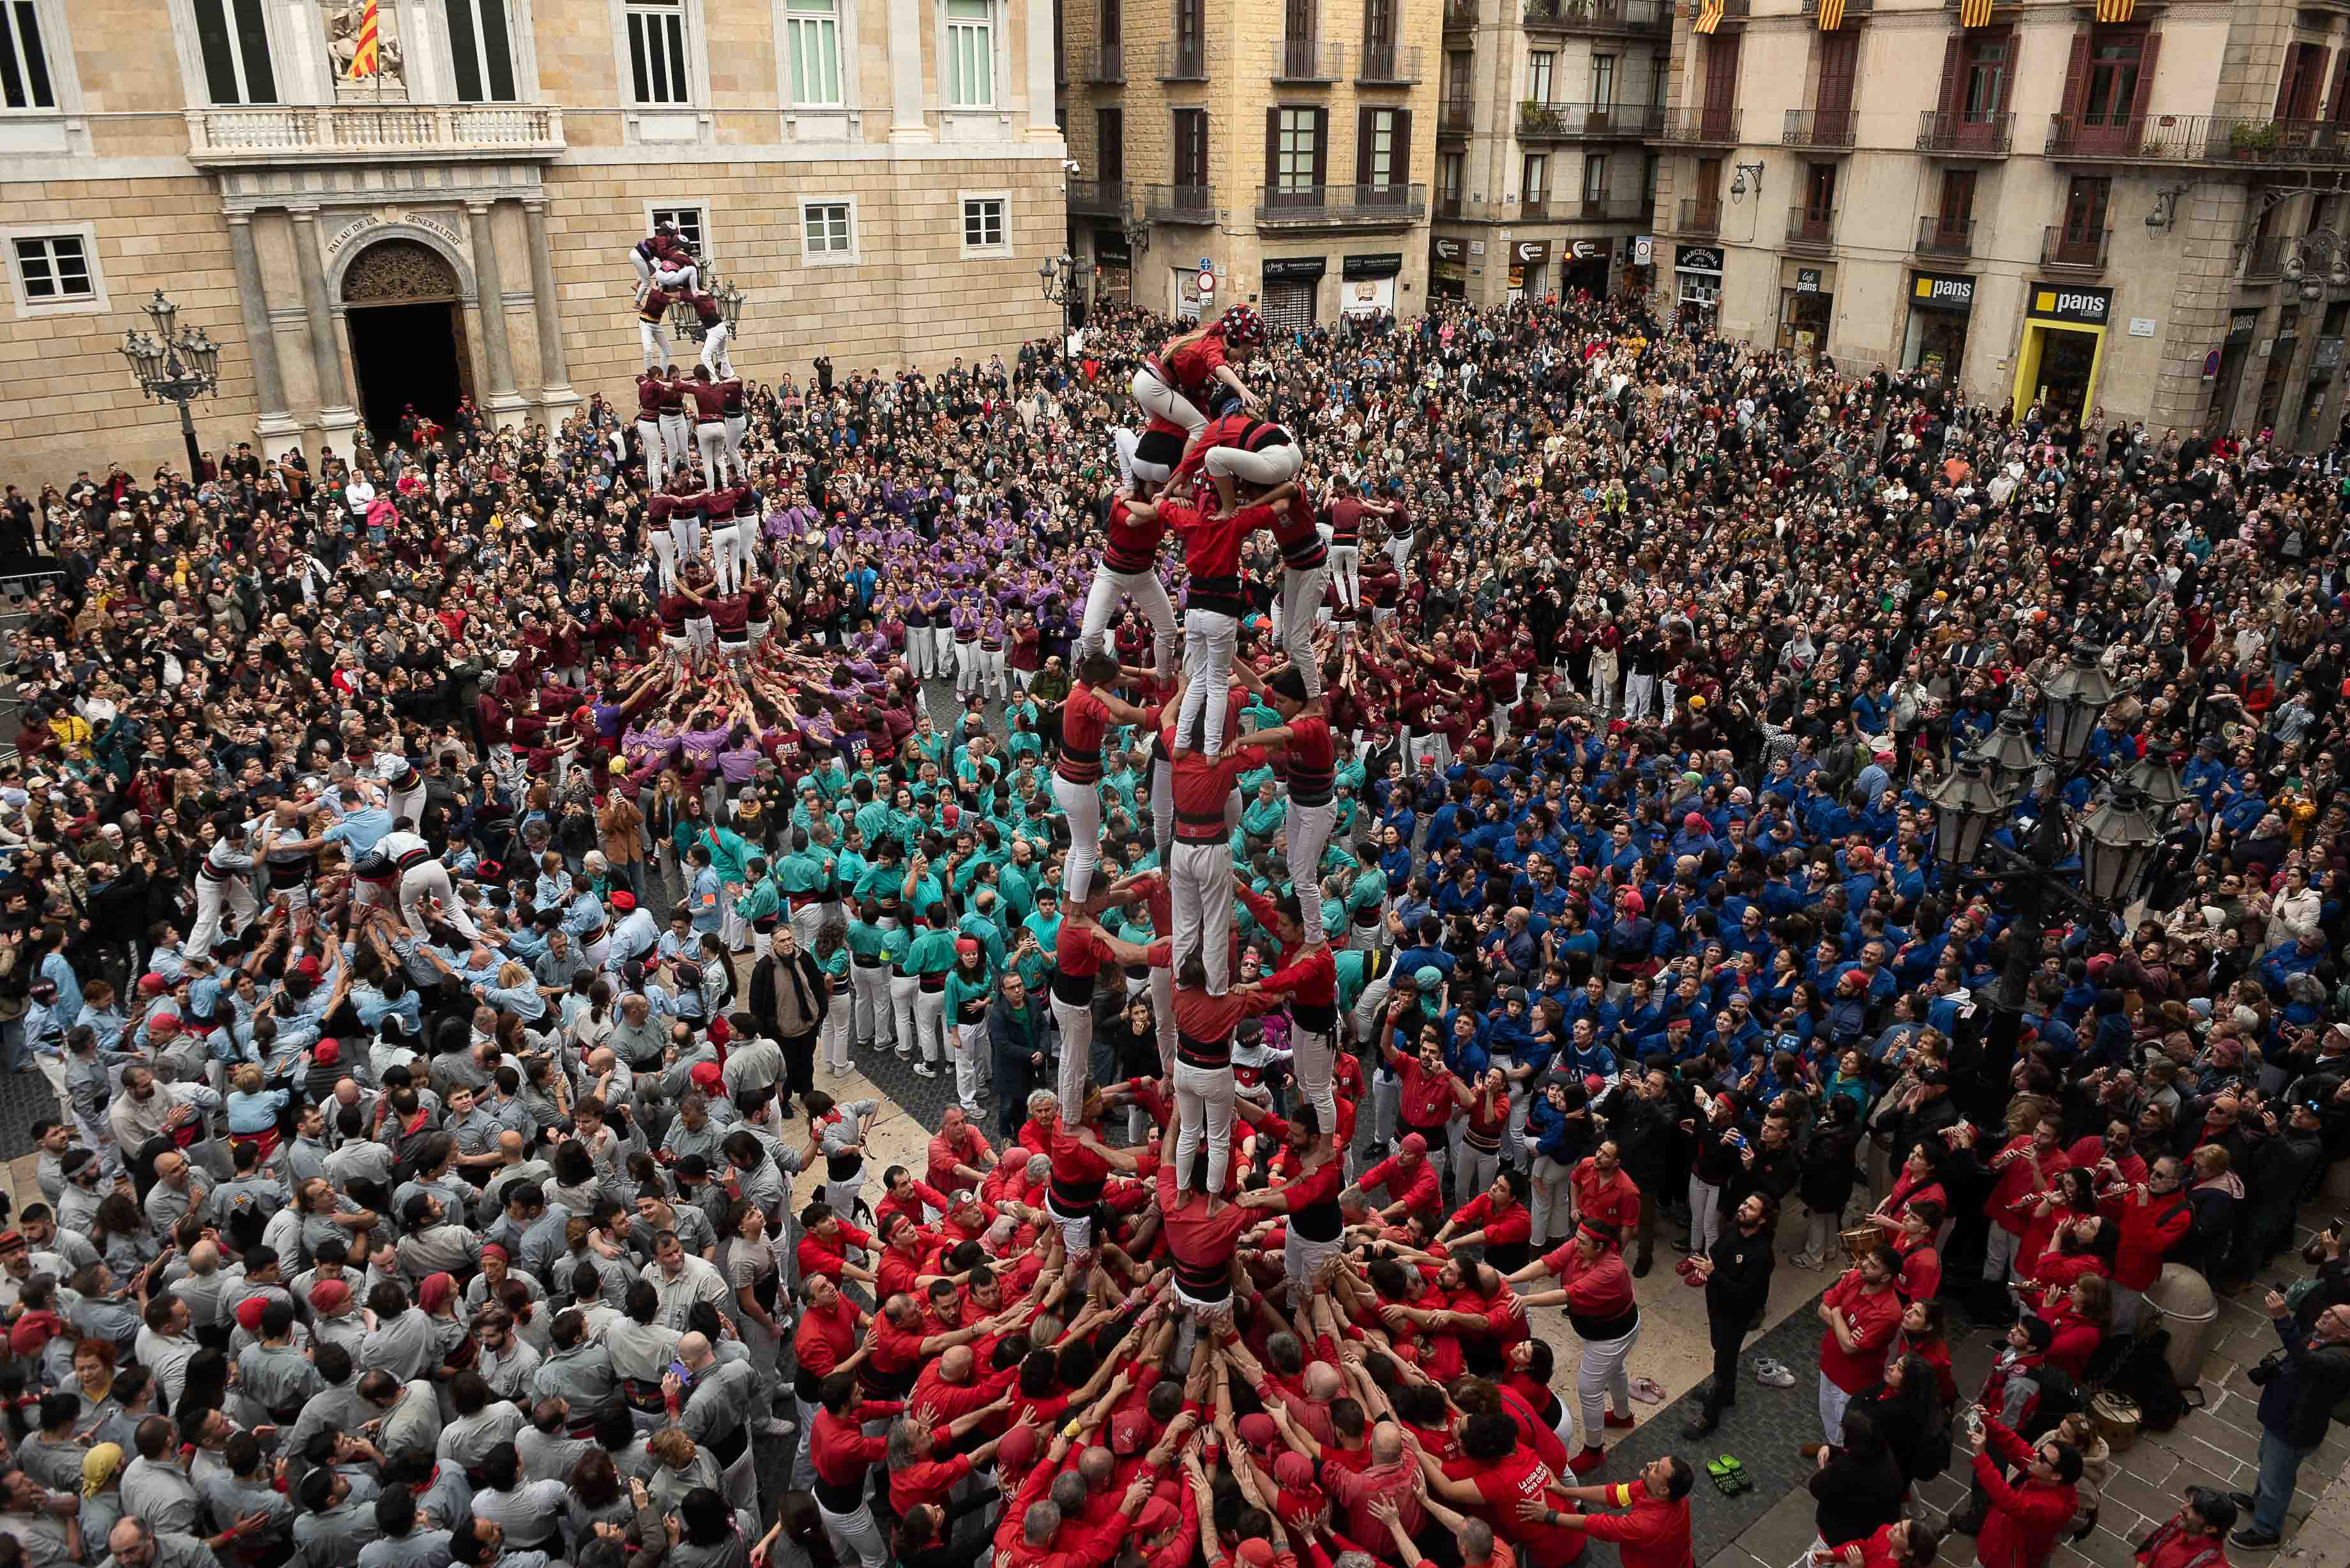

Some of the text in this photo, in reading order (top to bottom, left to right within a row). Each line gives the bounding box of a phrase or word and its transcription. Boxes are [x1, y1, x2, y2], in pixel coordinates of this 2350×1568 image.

[328, 215, 461, 253] PALAU DE LA GENERALITAT
[1682, 249, 1717, 266] BARCELONA
[1797, 282, 1817, 292] pans
[1933, 280, 1971, 298] pans
[2057, 293, 2105, 313] pans
[2231, 315, 2254, 336] pans
[2280, 329, 2294, 342] pans
[1517, 1481, 1527, 1489] La
[1526, 1472, 1537, 1484] colla
[1535, 1465, 1542, 1474] de
[1524, 1482, 1537, 1495] teva
